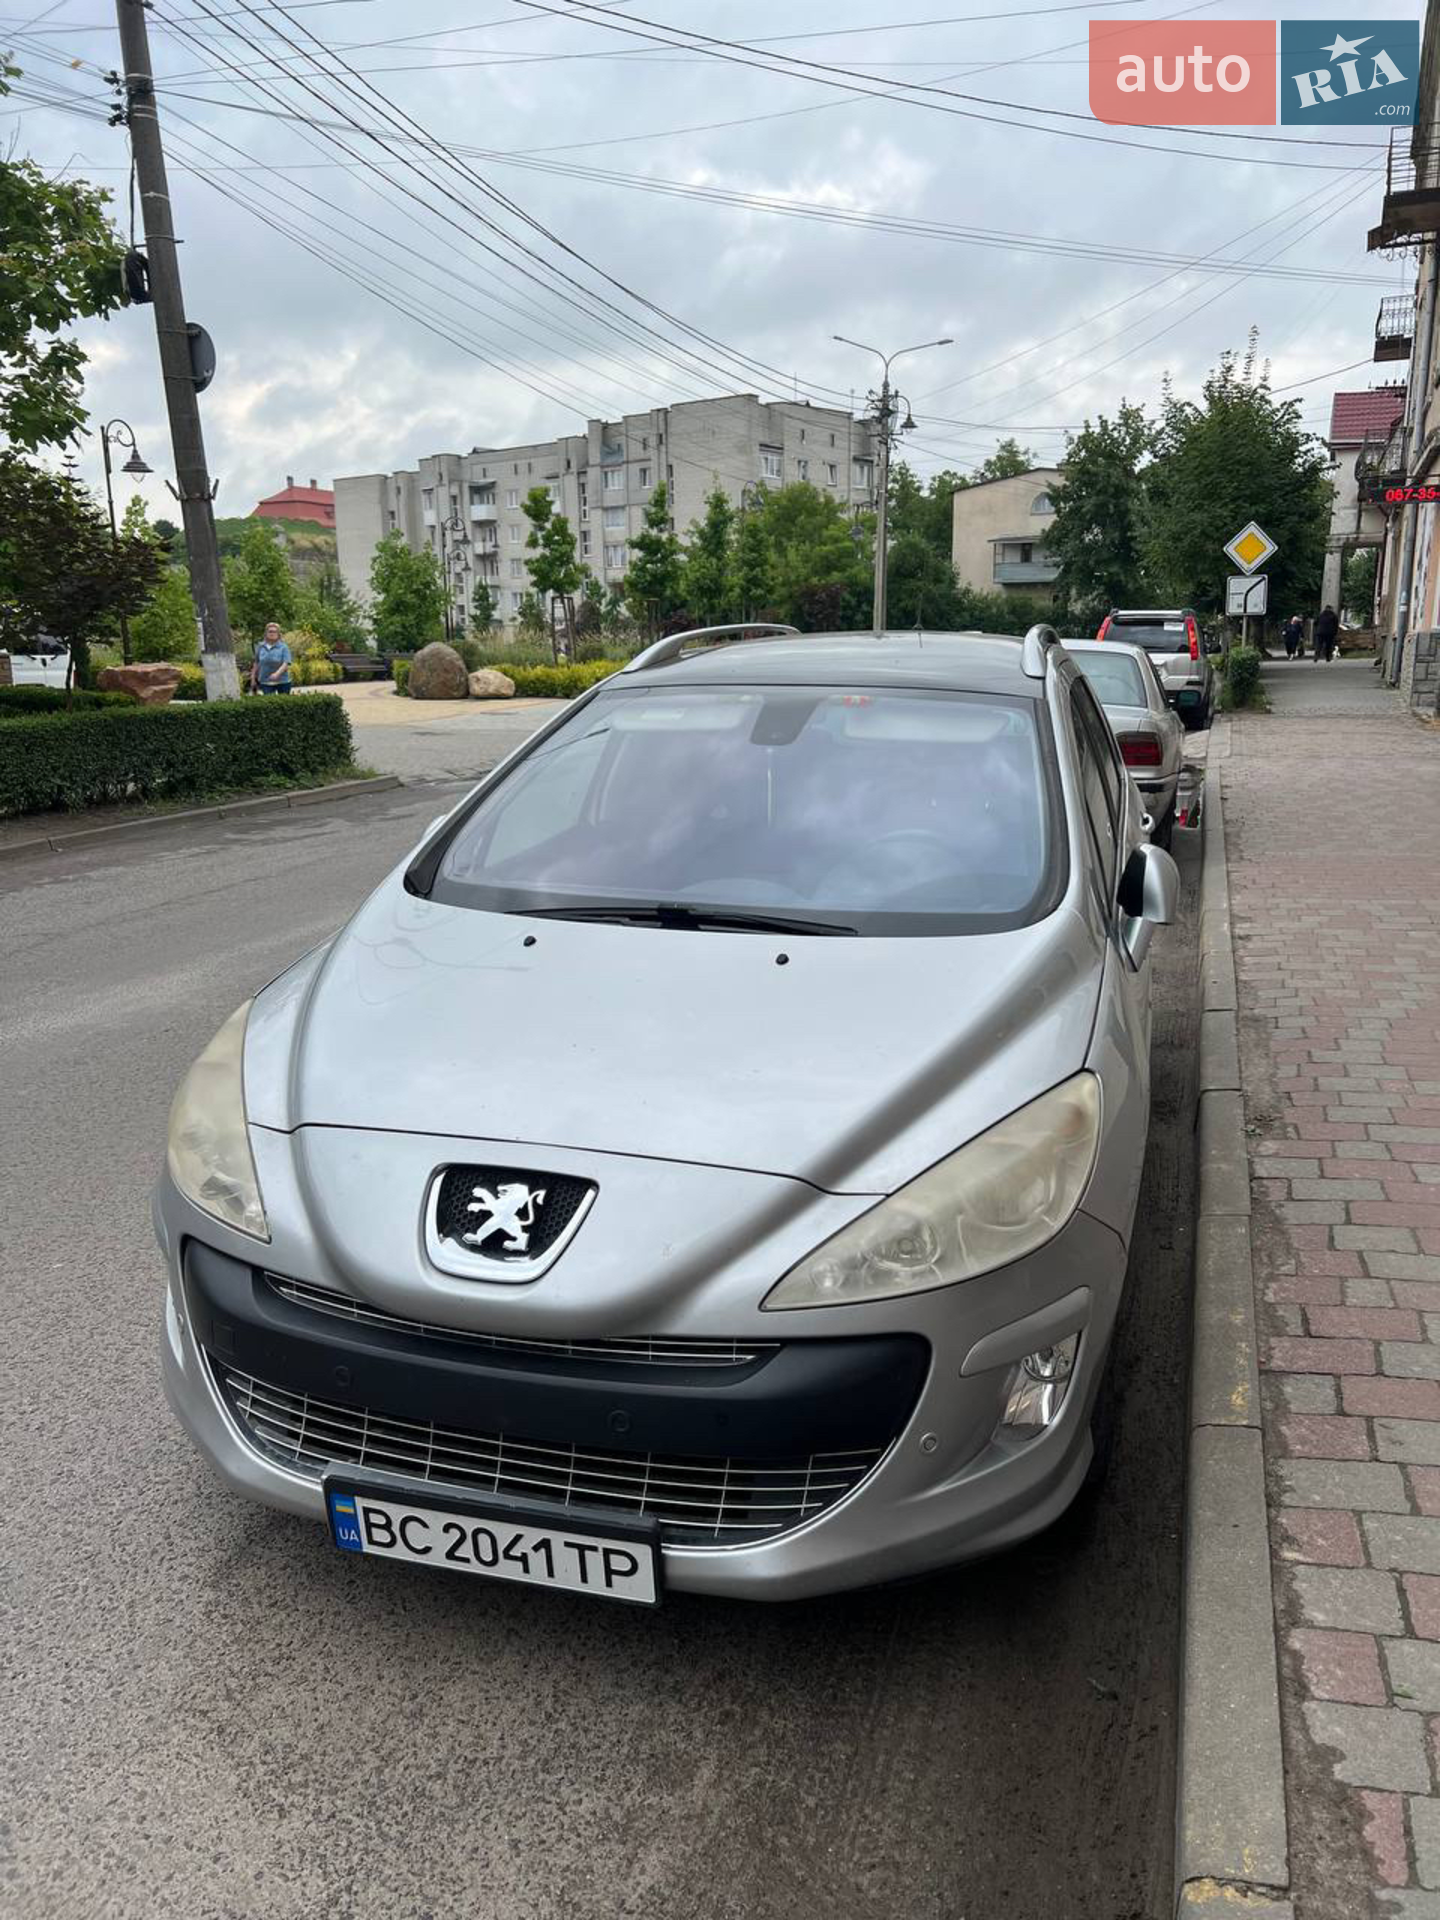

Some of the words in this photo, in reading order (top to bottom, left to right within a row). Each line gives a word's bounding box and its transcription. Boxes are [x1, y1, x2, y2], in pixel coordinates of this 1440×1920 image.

[339, 1528, 360, 1543] UA
[362, 1506, 432, 1555] BC
[442, 1522, 555, 1578] 2041
[563, 1541, 639, 1588] TP
